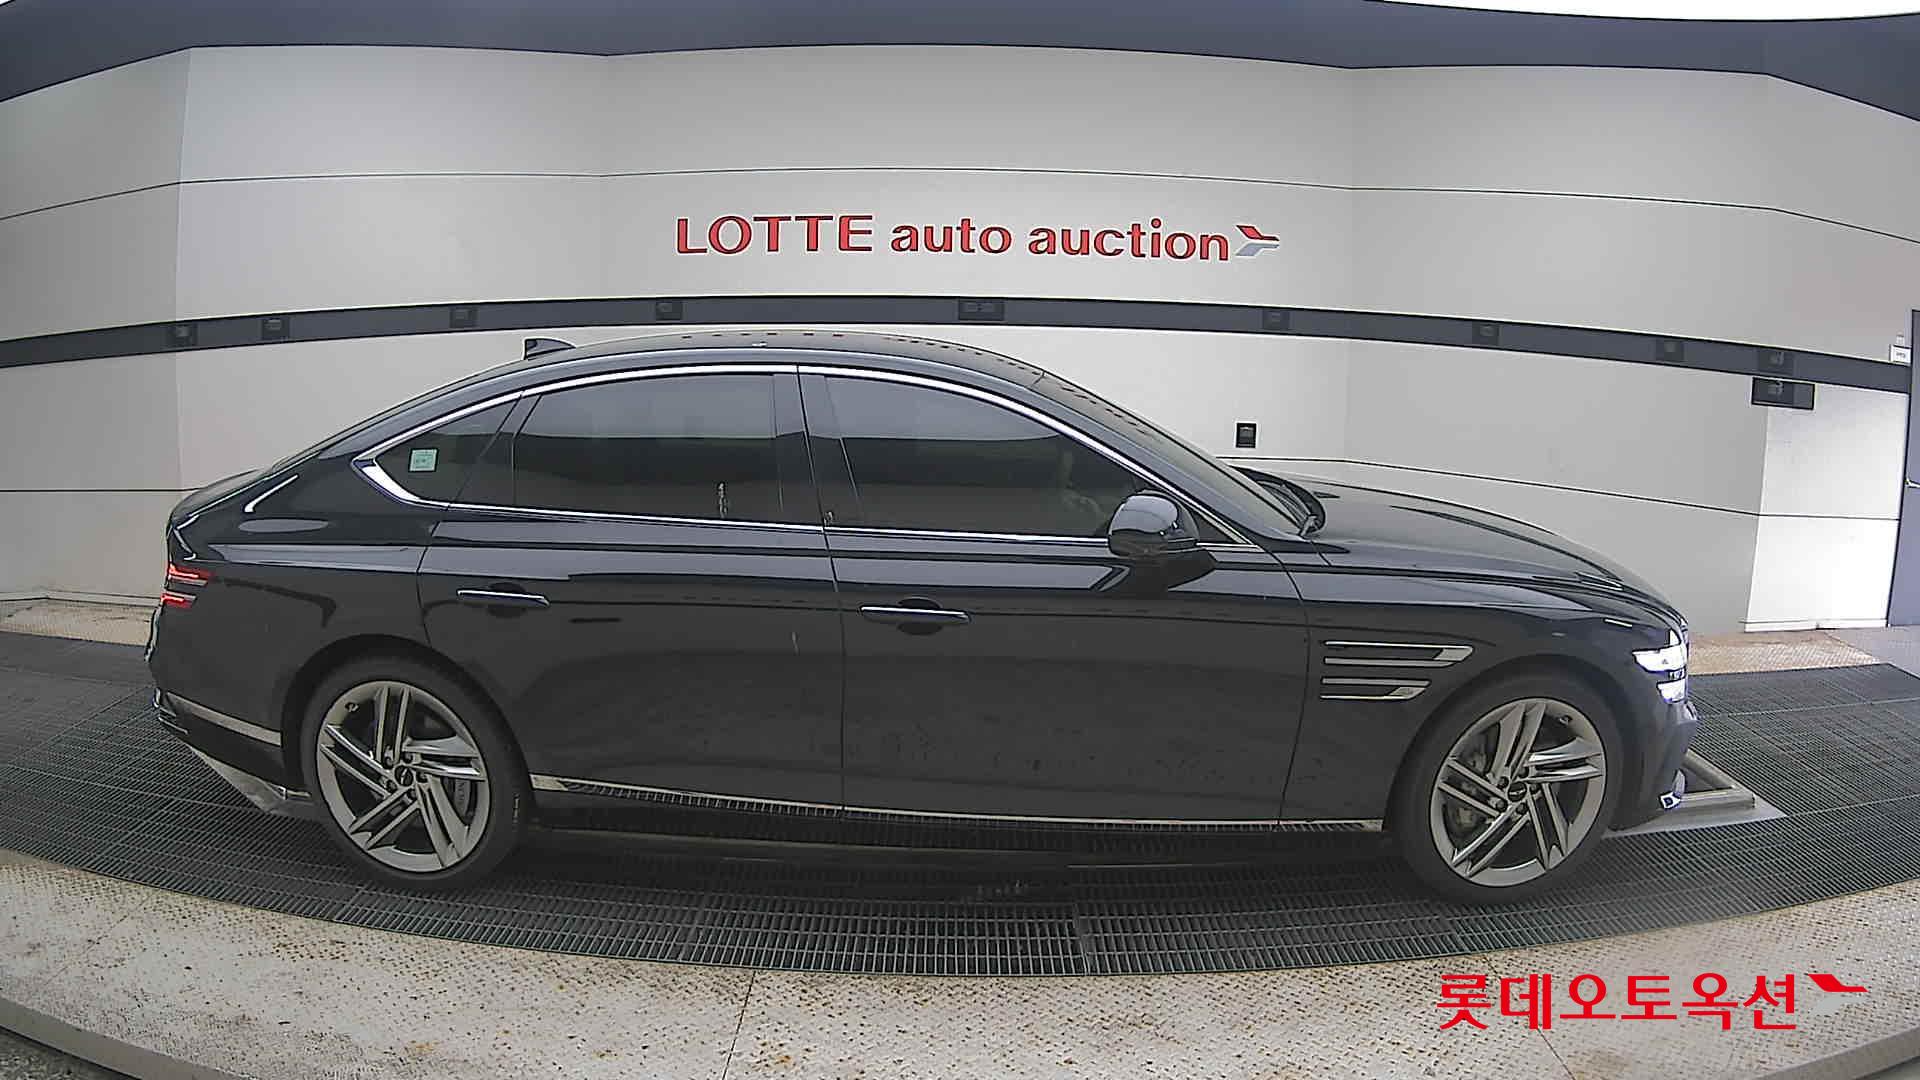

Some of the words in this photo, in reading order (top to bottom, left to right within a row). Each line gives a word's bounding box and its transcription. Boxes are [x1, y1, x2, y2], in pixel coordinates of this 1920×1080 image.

[676, 215, 872, 255] LOTTE
[890, 218, 1013, 254] auto
[1028, 217, 1230, 262] auction
